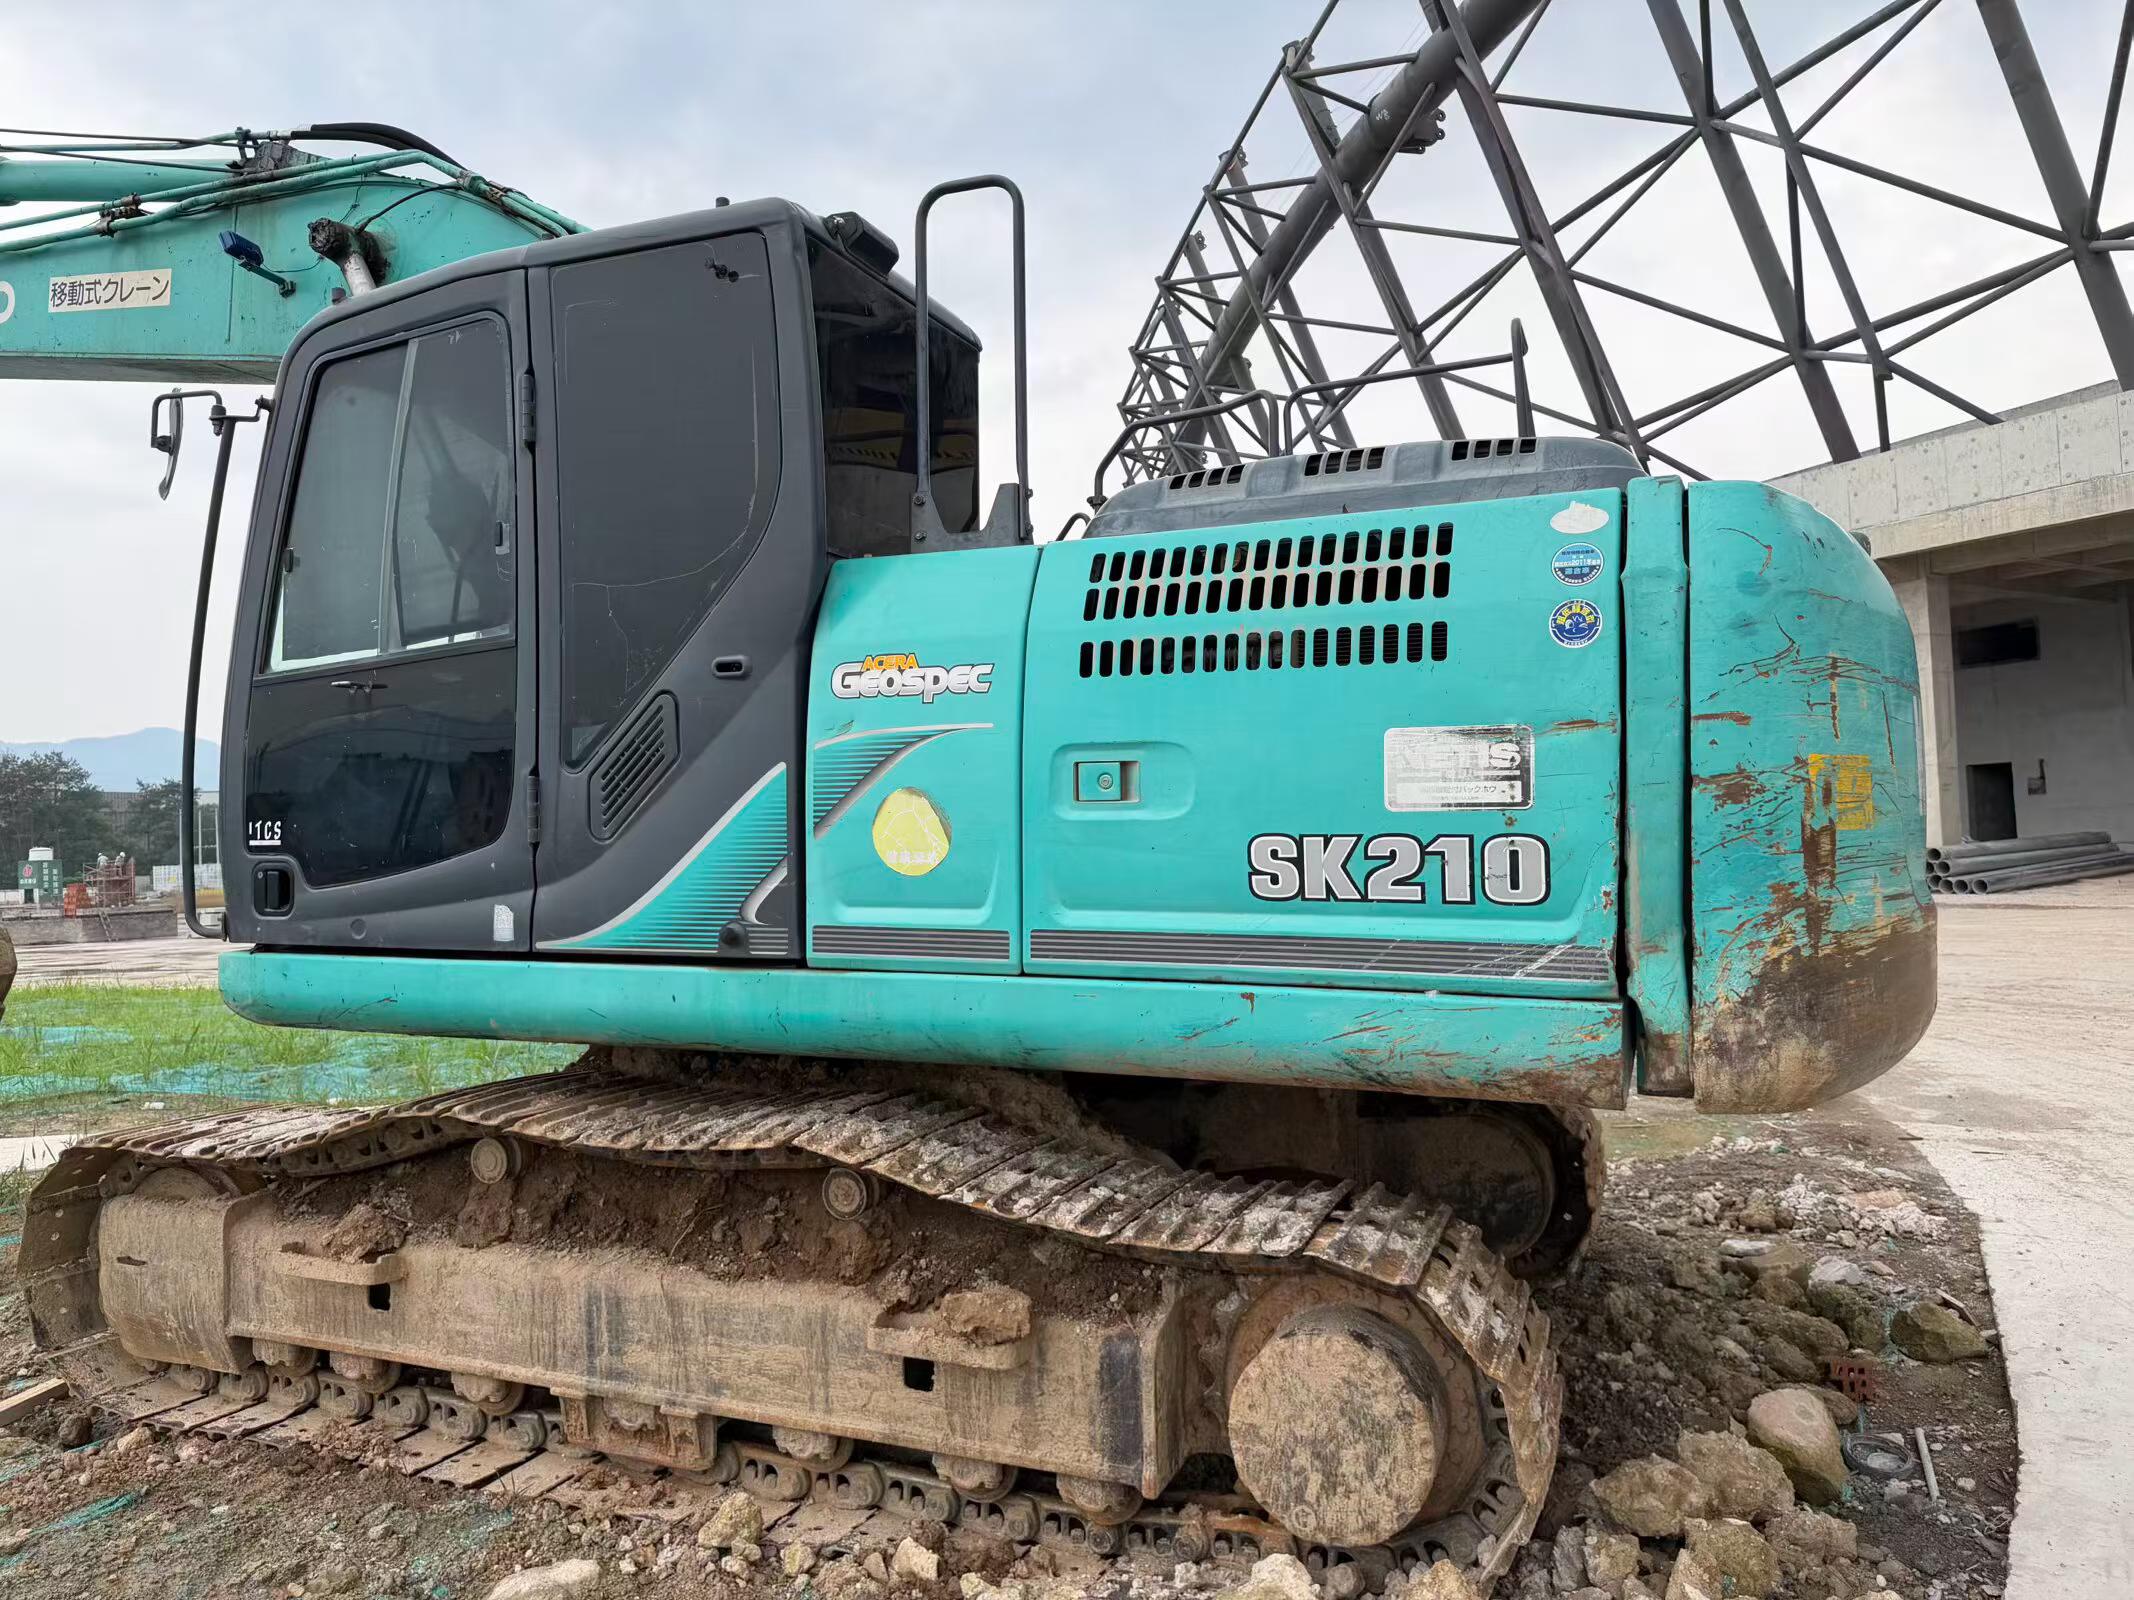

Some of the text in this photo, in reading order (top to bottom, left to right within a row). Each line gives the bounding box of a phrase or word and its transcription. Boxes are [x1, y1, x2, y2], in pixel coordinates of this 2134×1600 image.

[50, 276, 170, 308] 移動式クレーン
[861, 653, 919, 671] ACERA
[1248, 832, 1551, 905] SK210
